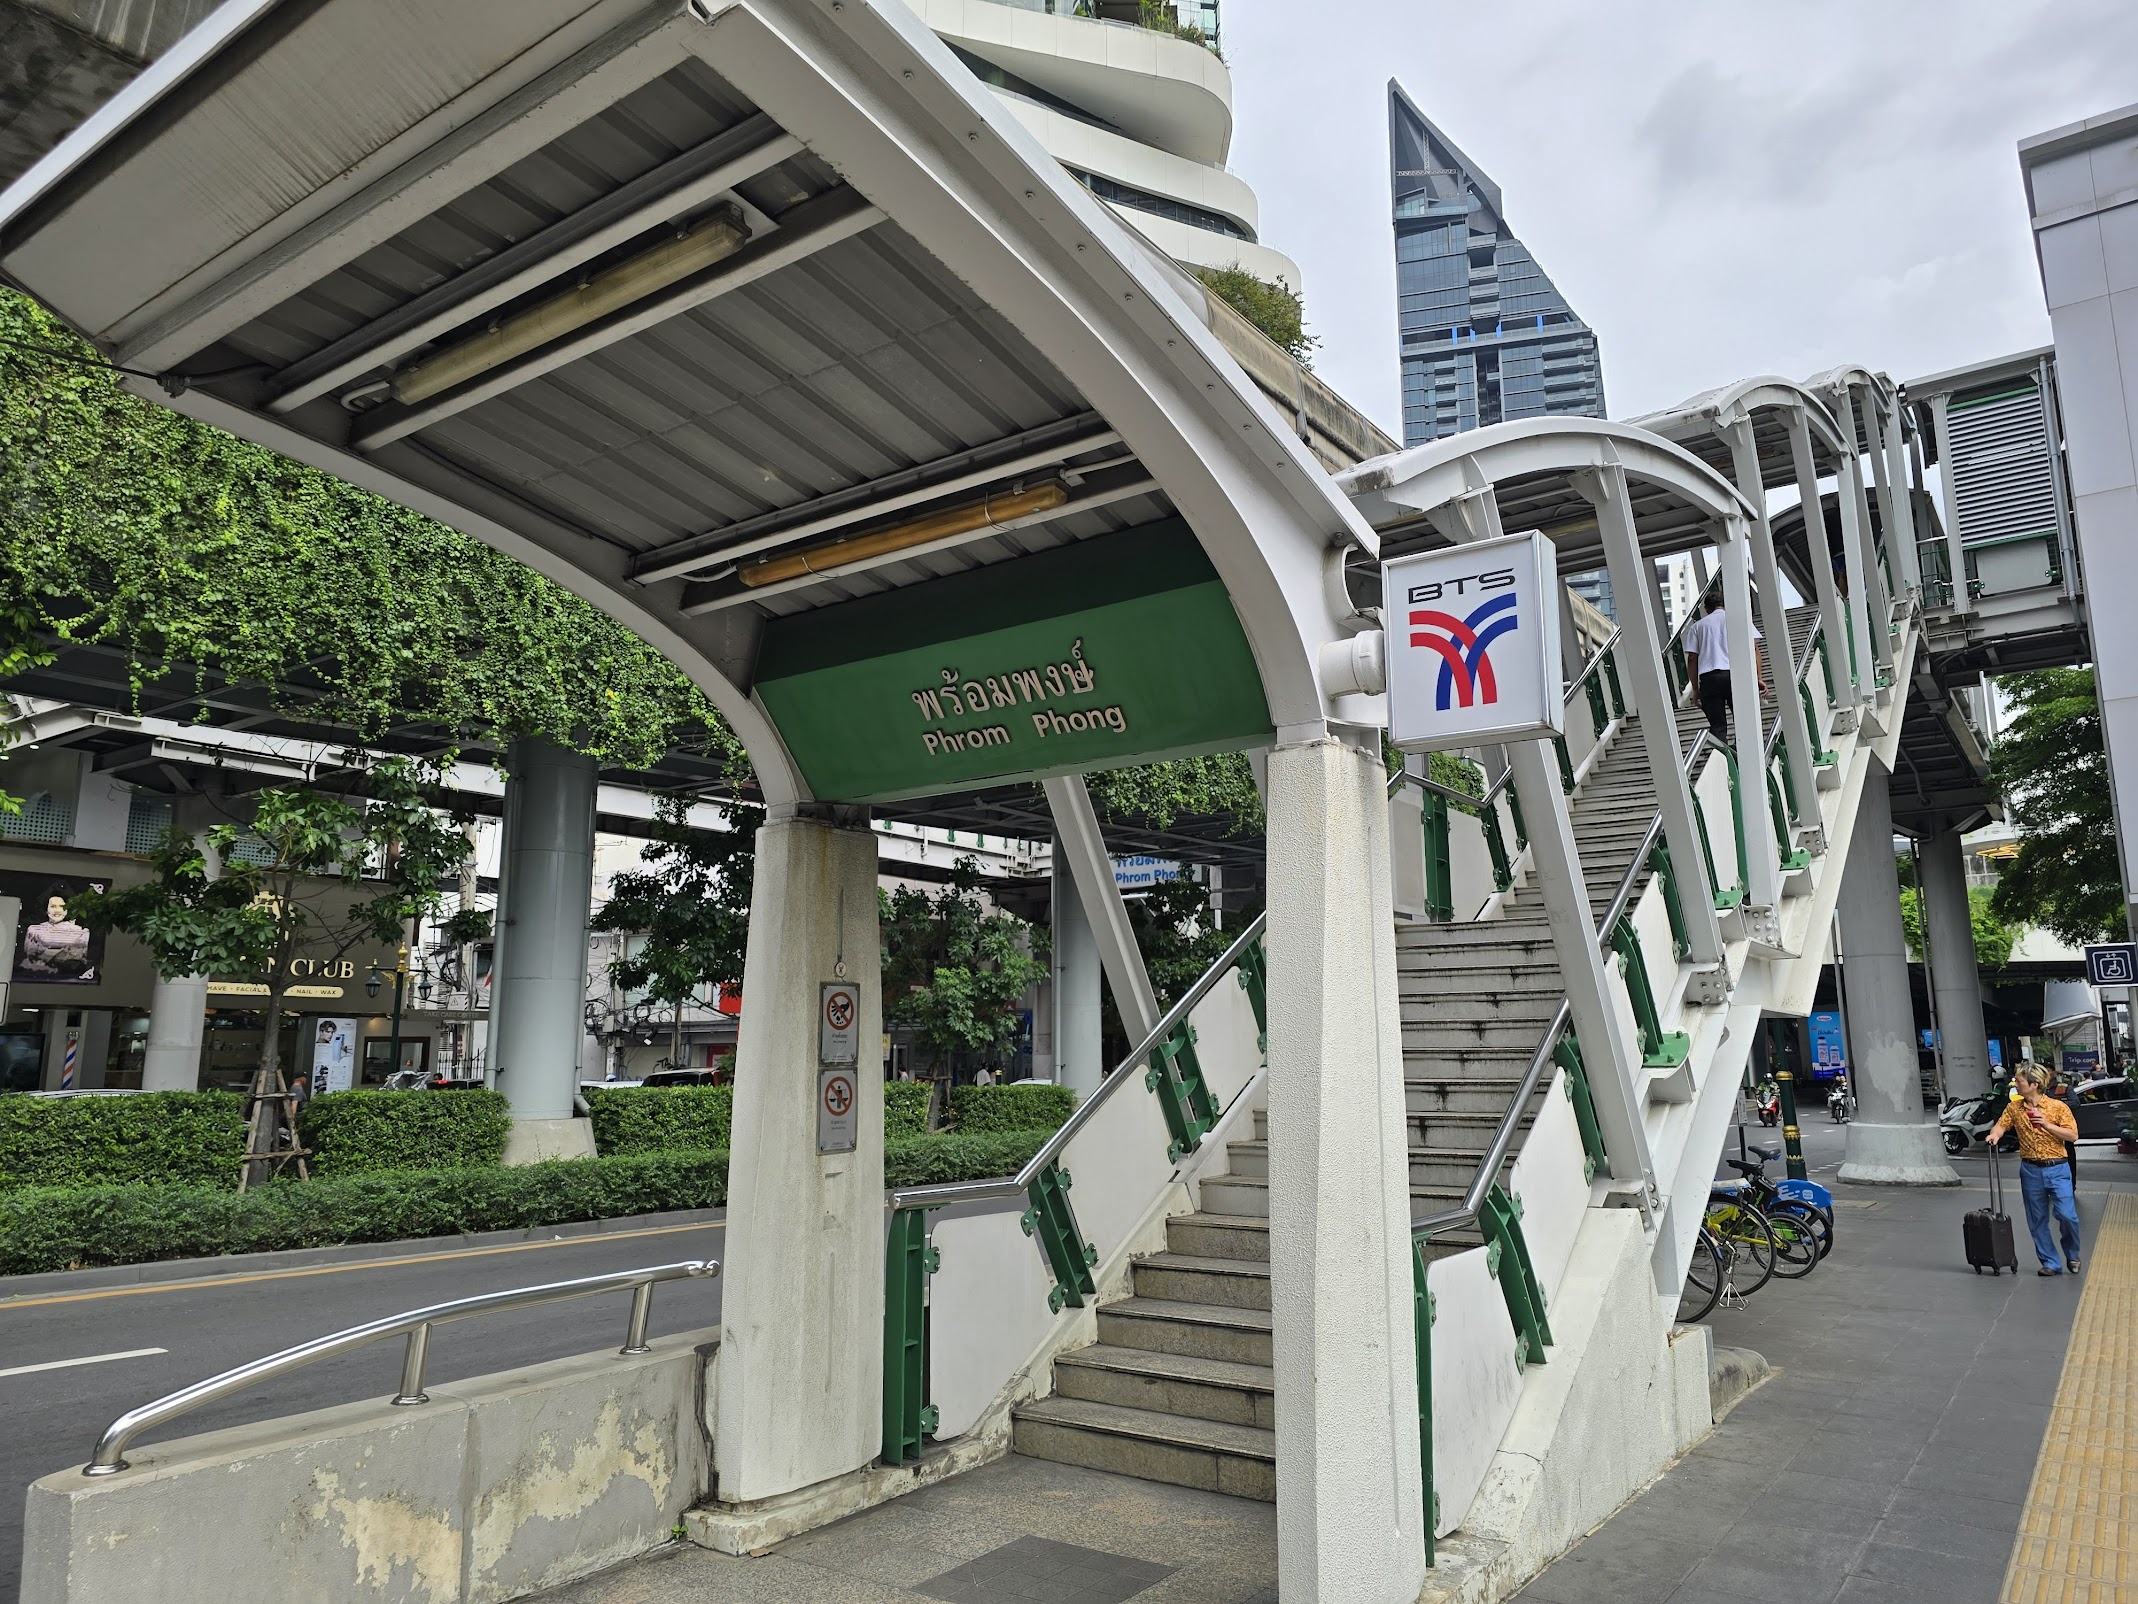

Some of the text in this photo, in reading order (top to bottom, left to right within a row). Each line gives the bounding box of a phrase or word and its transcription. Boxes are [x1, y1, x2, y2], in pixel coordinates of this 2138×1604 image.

[1408, 568, 1516, 604] BTS
[911, 639, 1094, 722] พร้อมพงษ์
[922, 706, 1127, 756] Phrom Phong
[1115, 869, 1180, 883] Phrom Pho
[290, 958, 354, 979] CLUB
[2068, 1056, 2096, 1064] Trip.com
